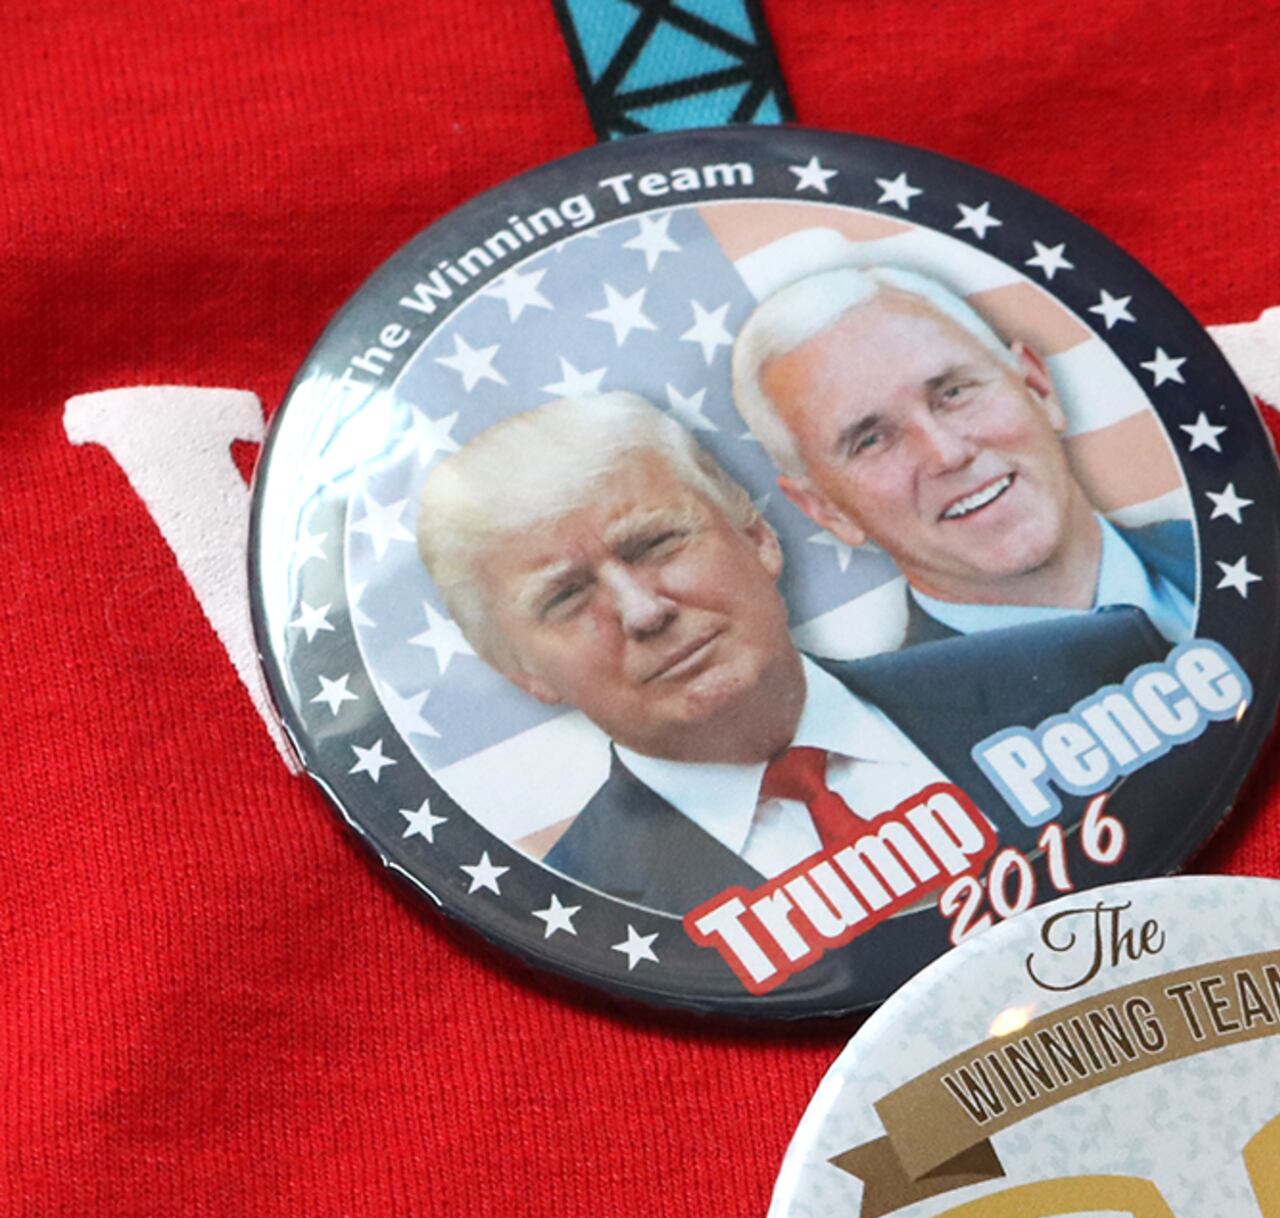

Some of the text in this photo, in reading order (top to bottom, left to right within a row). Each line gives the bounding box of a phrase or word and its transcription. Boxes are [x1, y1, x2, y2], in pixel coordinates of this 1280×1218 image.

[340, 160, 755, 396] The Winning Team
[978, 642, 1248, 822] Pence
[689, 786, 991, 990] Trump
[939, 792, 1128, 950] 2016
[1025, 899, 1166, 993] The
[941, 996, 1168, 1127] WINNING
